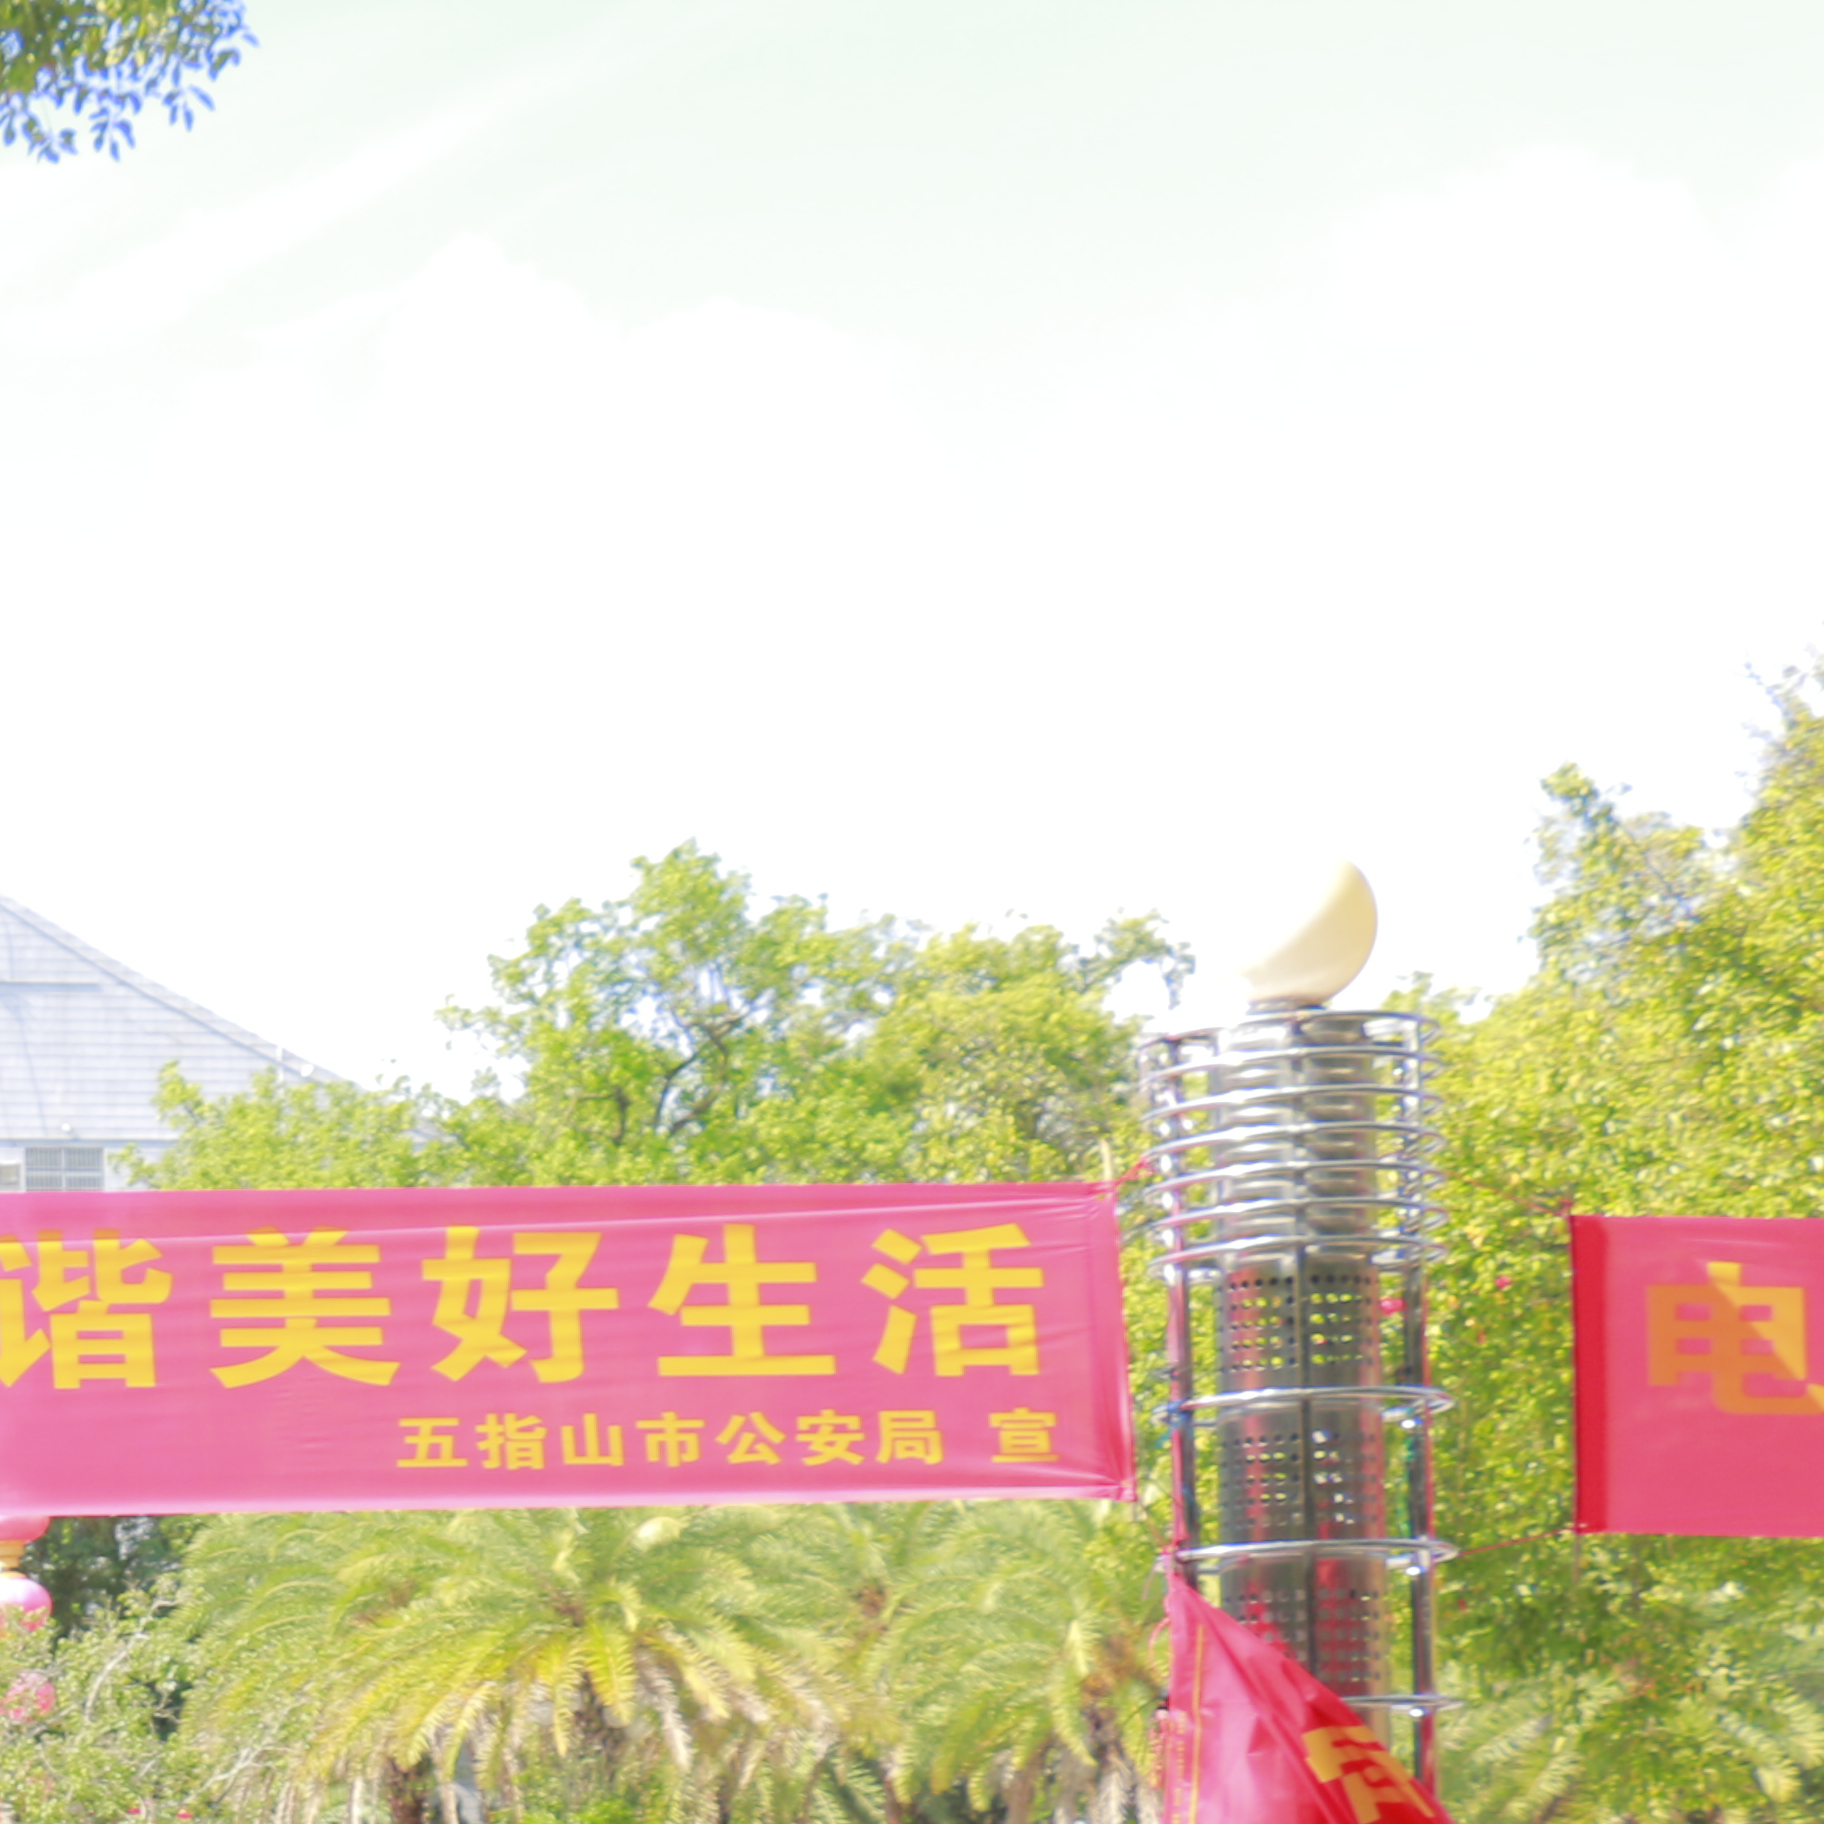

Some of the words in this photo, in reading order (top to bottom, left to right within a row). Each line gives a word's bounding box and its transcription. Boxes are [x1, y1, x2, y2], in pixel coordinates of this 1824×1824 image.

[396, 1408, 946, 1474] 五指山市公安局
[988, 1406, 1061, 1468] 宣
